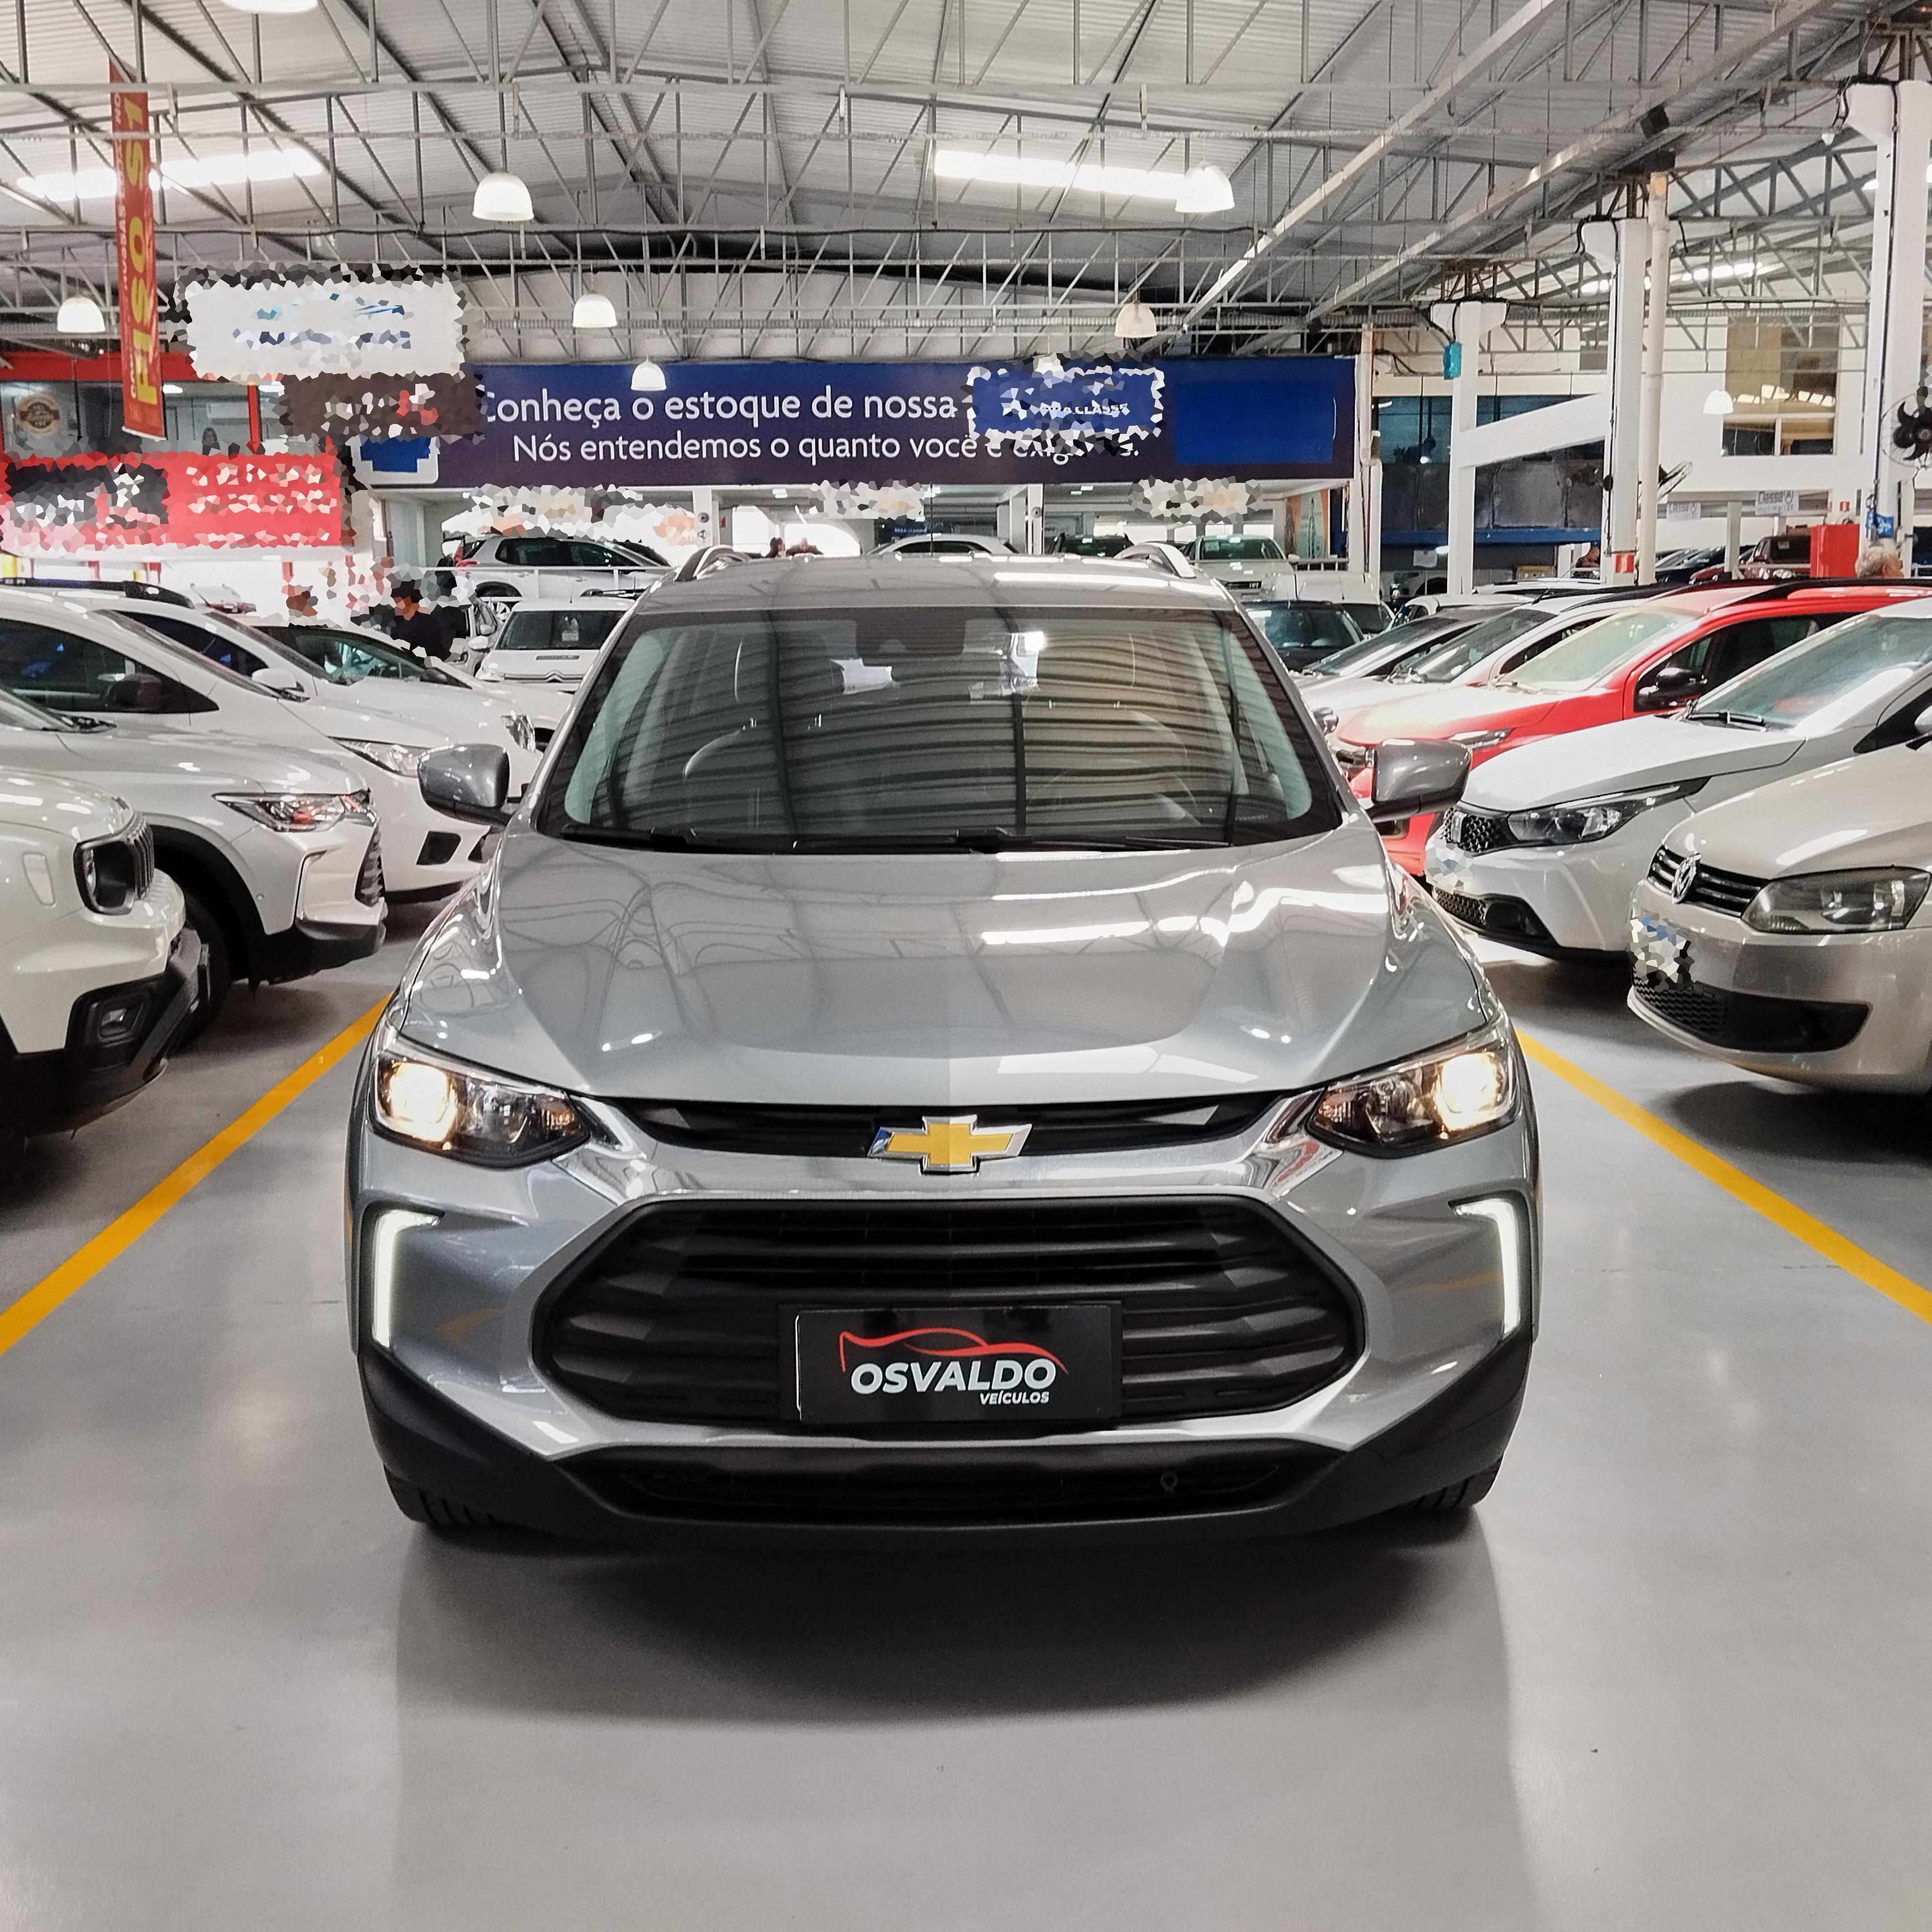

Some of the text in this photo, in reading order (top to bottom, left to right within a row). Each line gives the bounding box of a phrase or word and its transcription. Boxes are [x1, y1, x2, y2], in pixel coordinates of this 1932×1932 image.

[632, 397, 655, 420] o
[665, 391, 800, 427] estoque
[811, 385, 853, 418] de
[864, 396, 956, 418] nossa
[513, 433, 571, 461] Nós
[580, 430, 761, 460] entendemos
[771, 438, 789, 458] o
[799, 434, 900, 466] quanto
[851, 1358, 1057, 1394] OSVALDO
[979, 1390, 1050, 1405] VEÍCULOS
